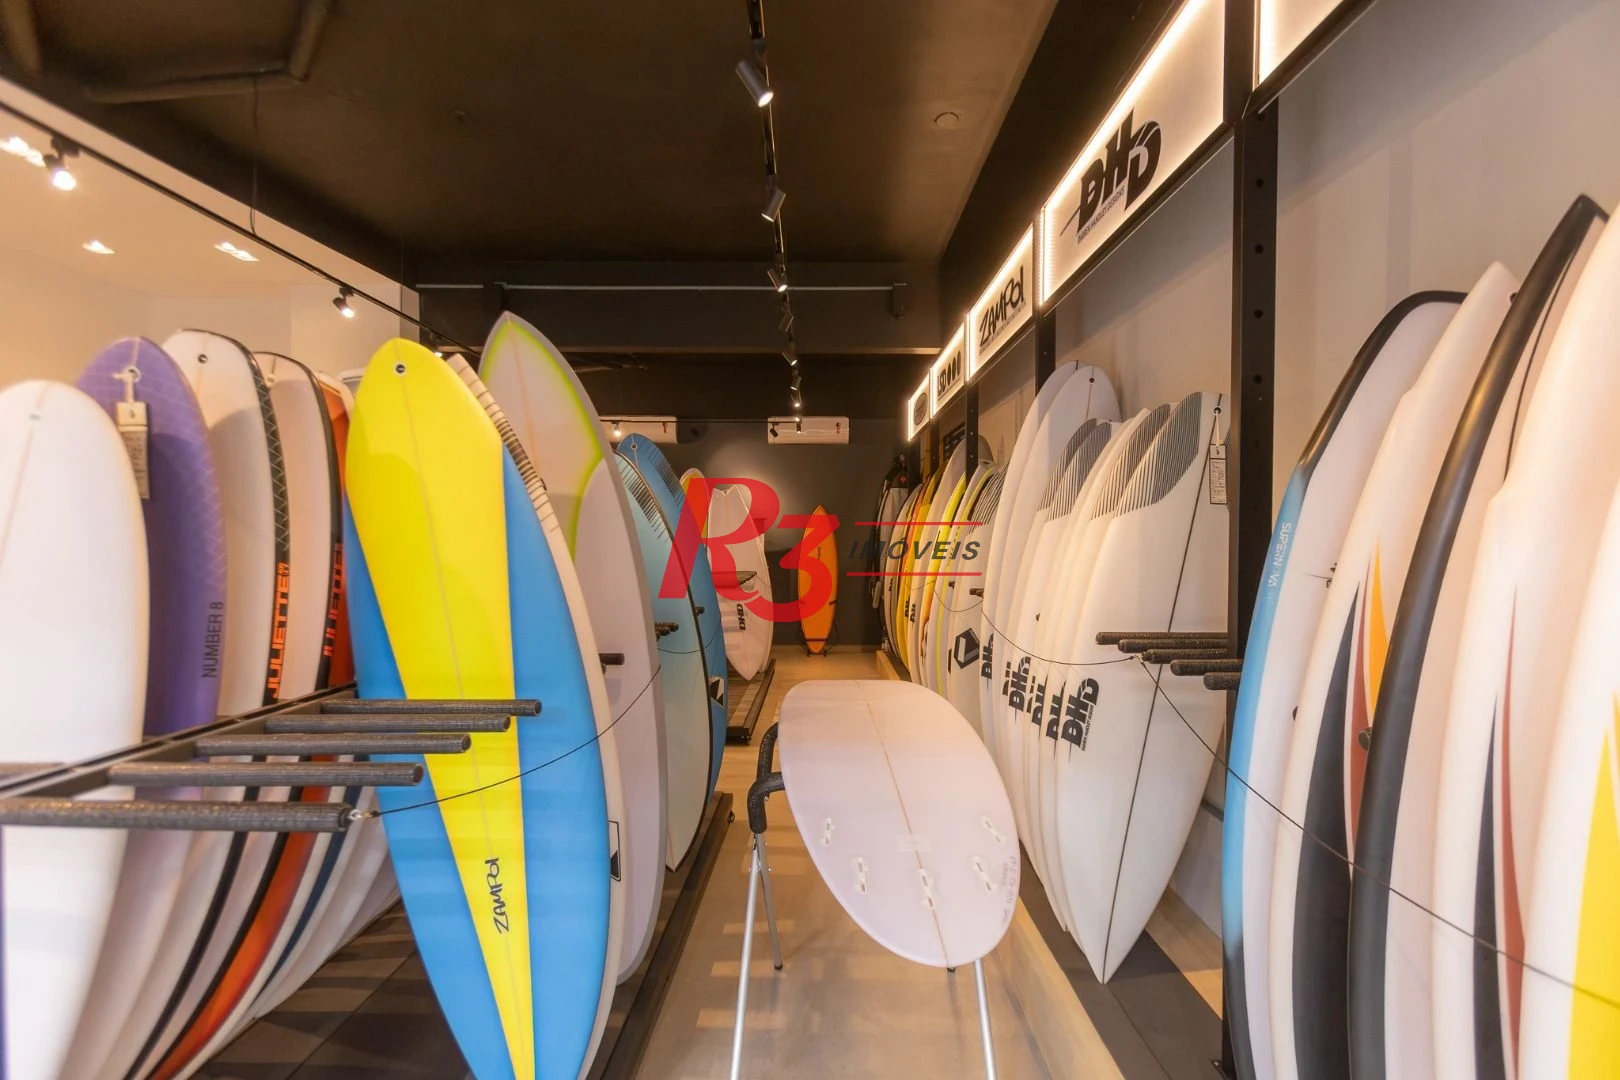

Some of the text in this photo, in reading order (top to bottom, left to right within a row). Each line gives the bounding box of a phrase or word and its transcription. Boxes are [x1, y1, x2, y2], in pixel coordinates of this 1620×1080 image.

[1060, 107, 1161, 237] DHD
[202, 601, 224, 677] NUMBER 8
[736, 603, 746, 630] DHD
[1061, 677, 1100, 748] DHD
